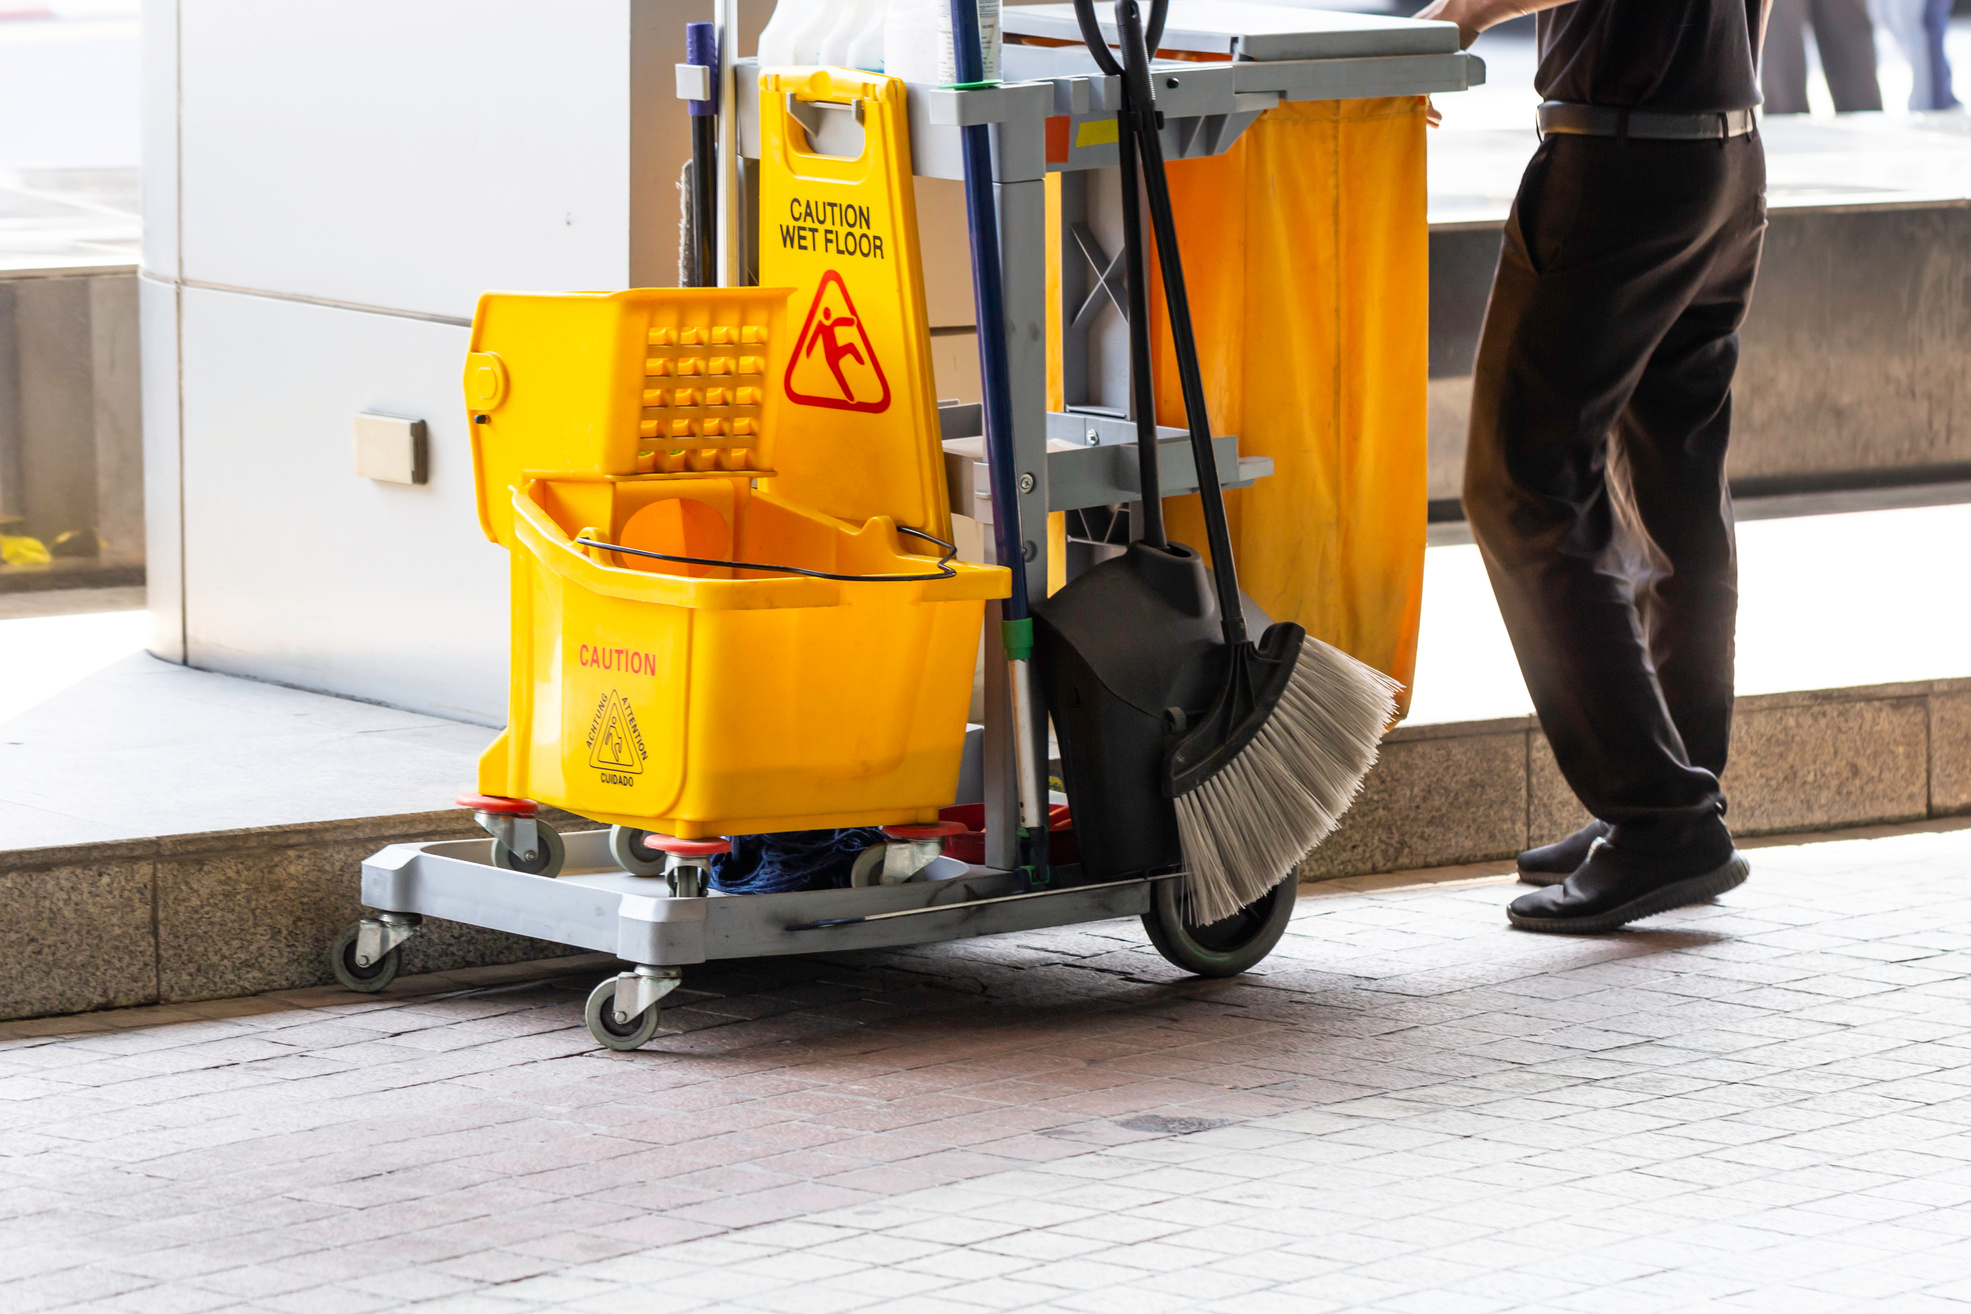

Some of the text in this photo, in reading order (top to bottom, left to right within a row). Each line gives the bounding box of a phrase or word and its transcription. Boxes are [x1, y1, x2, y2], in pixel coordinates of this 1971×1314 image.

[790, 197, 870, 230] CAUTION
[779, 223, 884, 259] WET FLOOR
[579, 643, 656, 676] CAUTION
[586, 692, 608, 750] ACHTUNG
[621, 696, 648, 761] ATTENTION
[600, 772, 634, 787] CUIDADO
